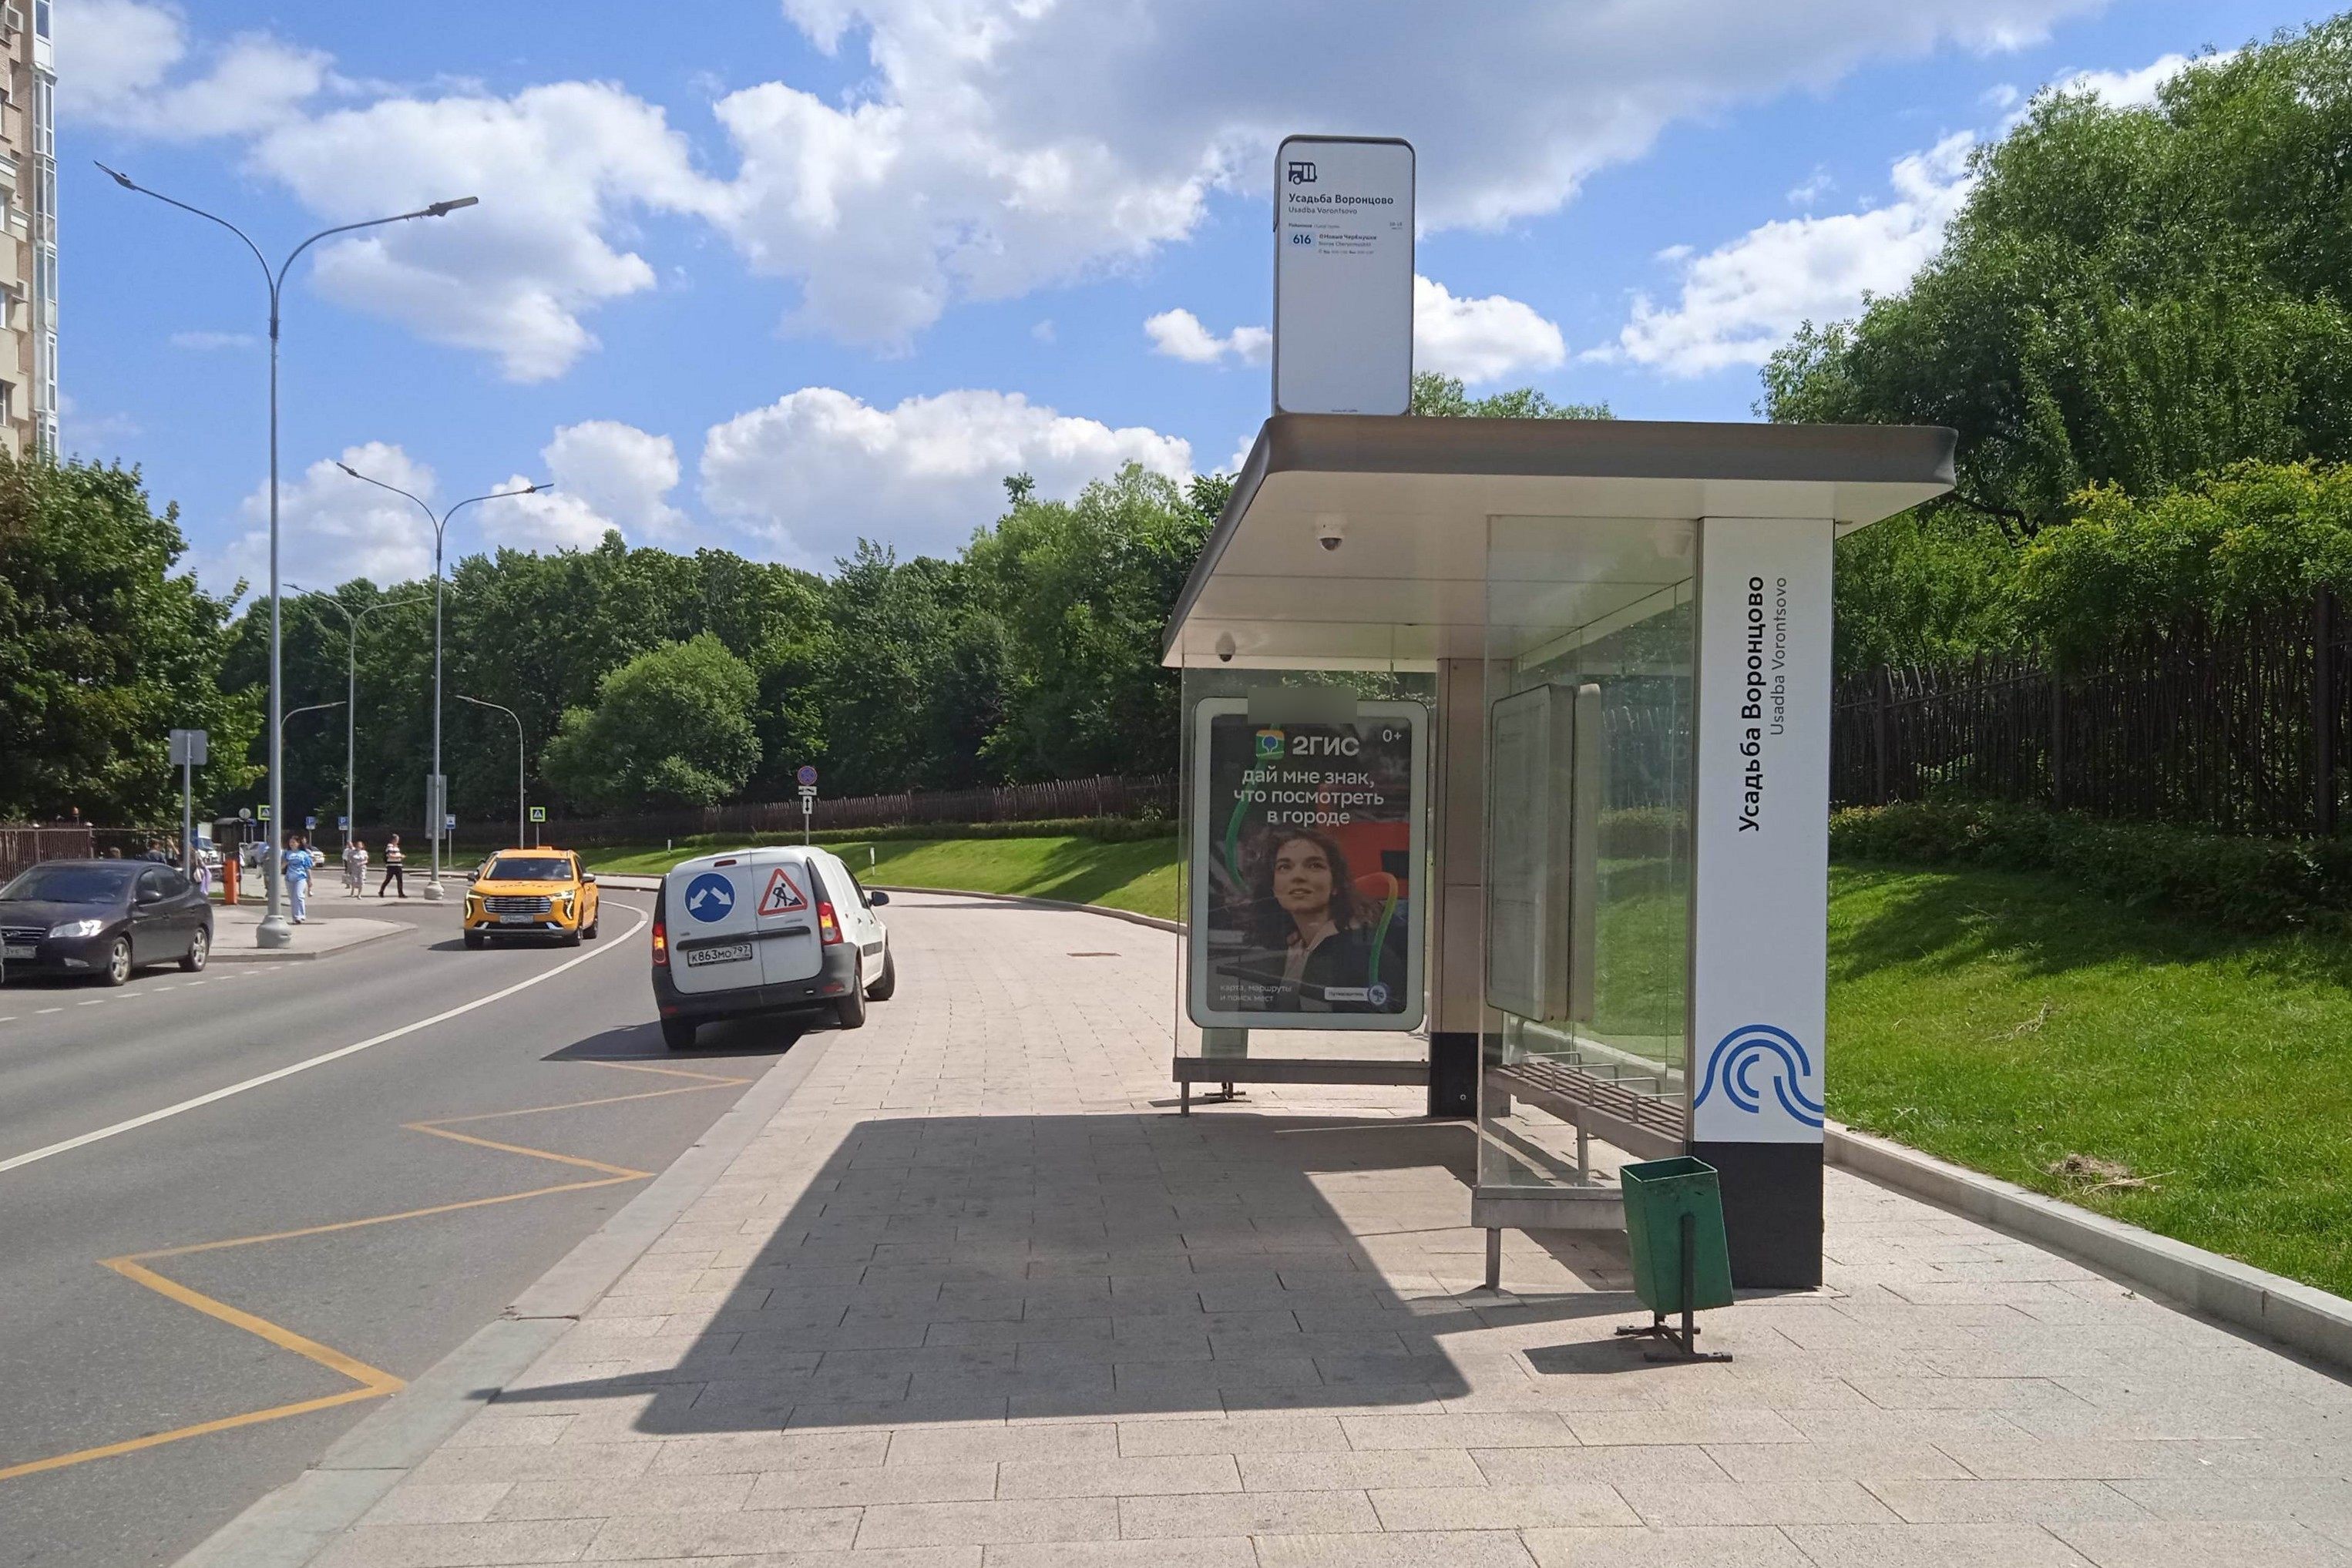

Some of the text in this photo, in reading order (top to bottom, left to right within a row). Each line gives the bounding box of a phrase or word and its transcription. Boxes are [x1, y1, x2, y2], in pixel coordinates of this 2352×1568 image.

[1289, 193, 1394, 206] Усадьба Воронцово
[1292, 233, 1311, 244] 616
[1770, 577, 1787, 735] Usadba Vorontsovo
[1739, 576, 1766, 832] Усадьба Воронцово
[1382, 729, 1402, 742] 0+
[1292, 736, 1360, 757] 2ГИС
[1242, 765, 1375, 787] дай мне знак,
[1234, 790, 1384, 808] что посмотреть
[1267, 811, 1350, 828] в городе
